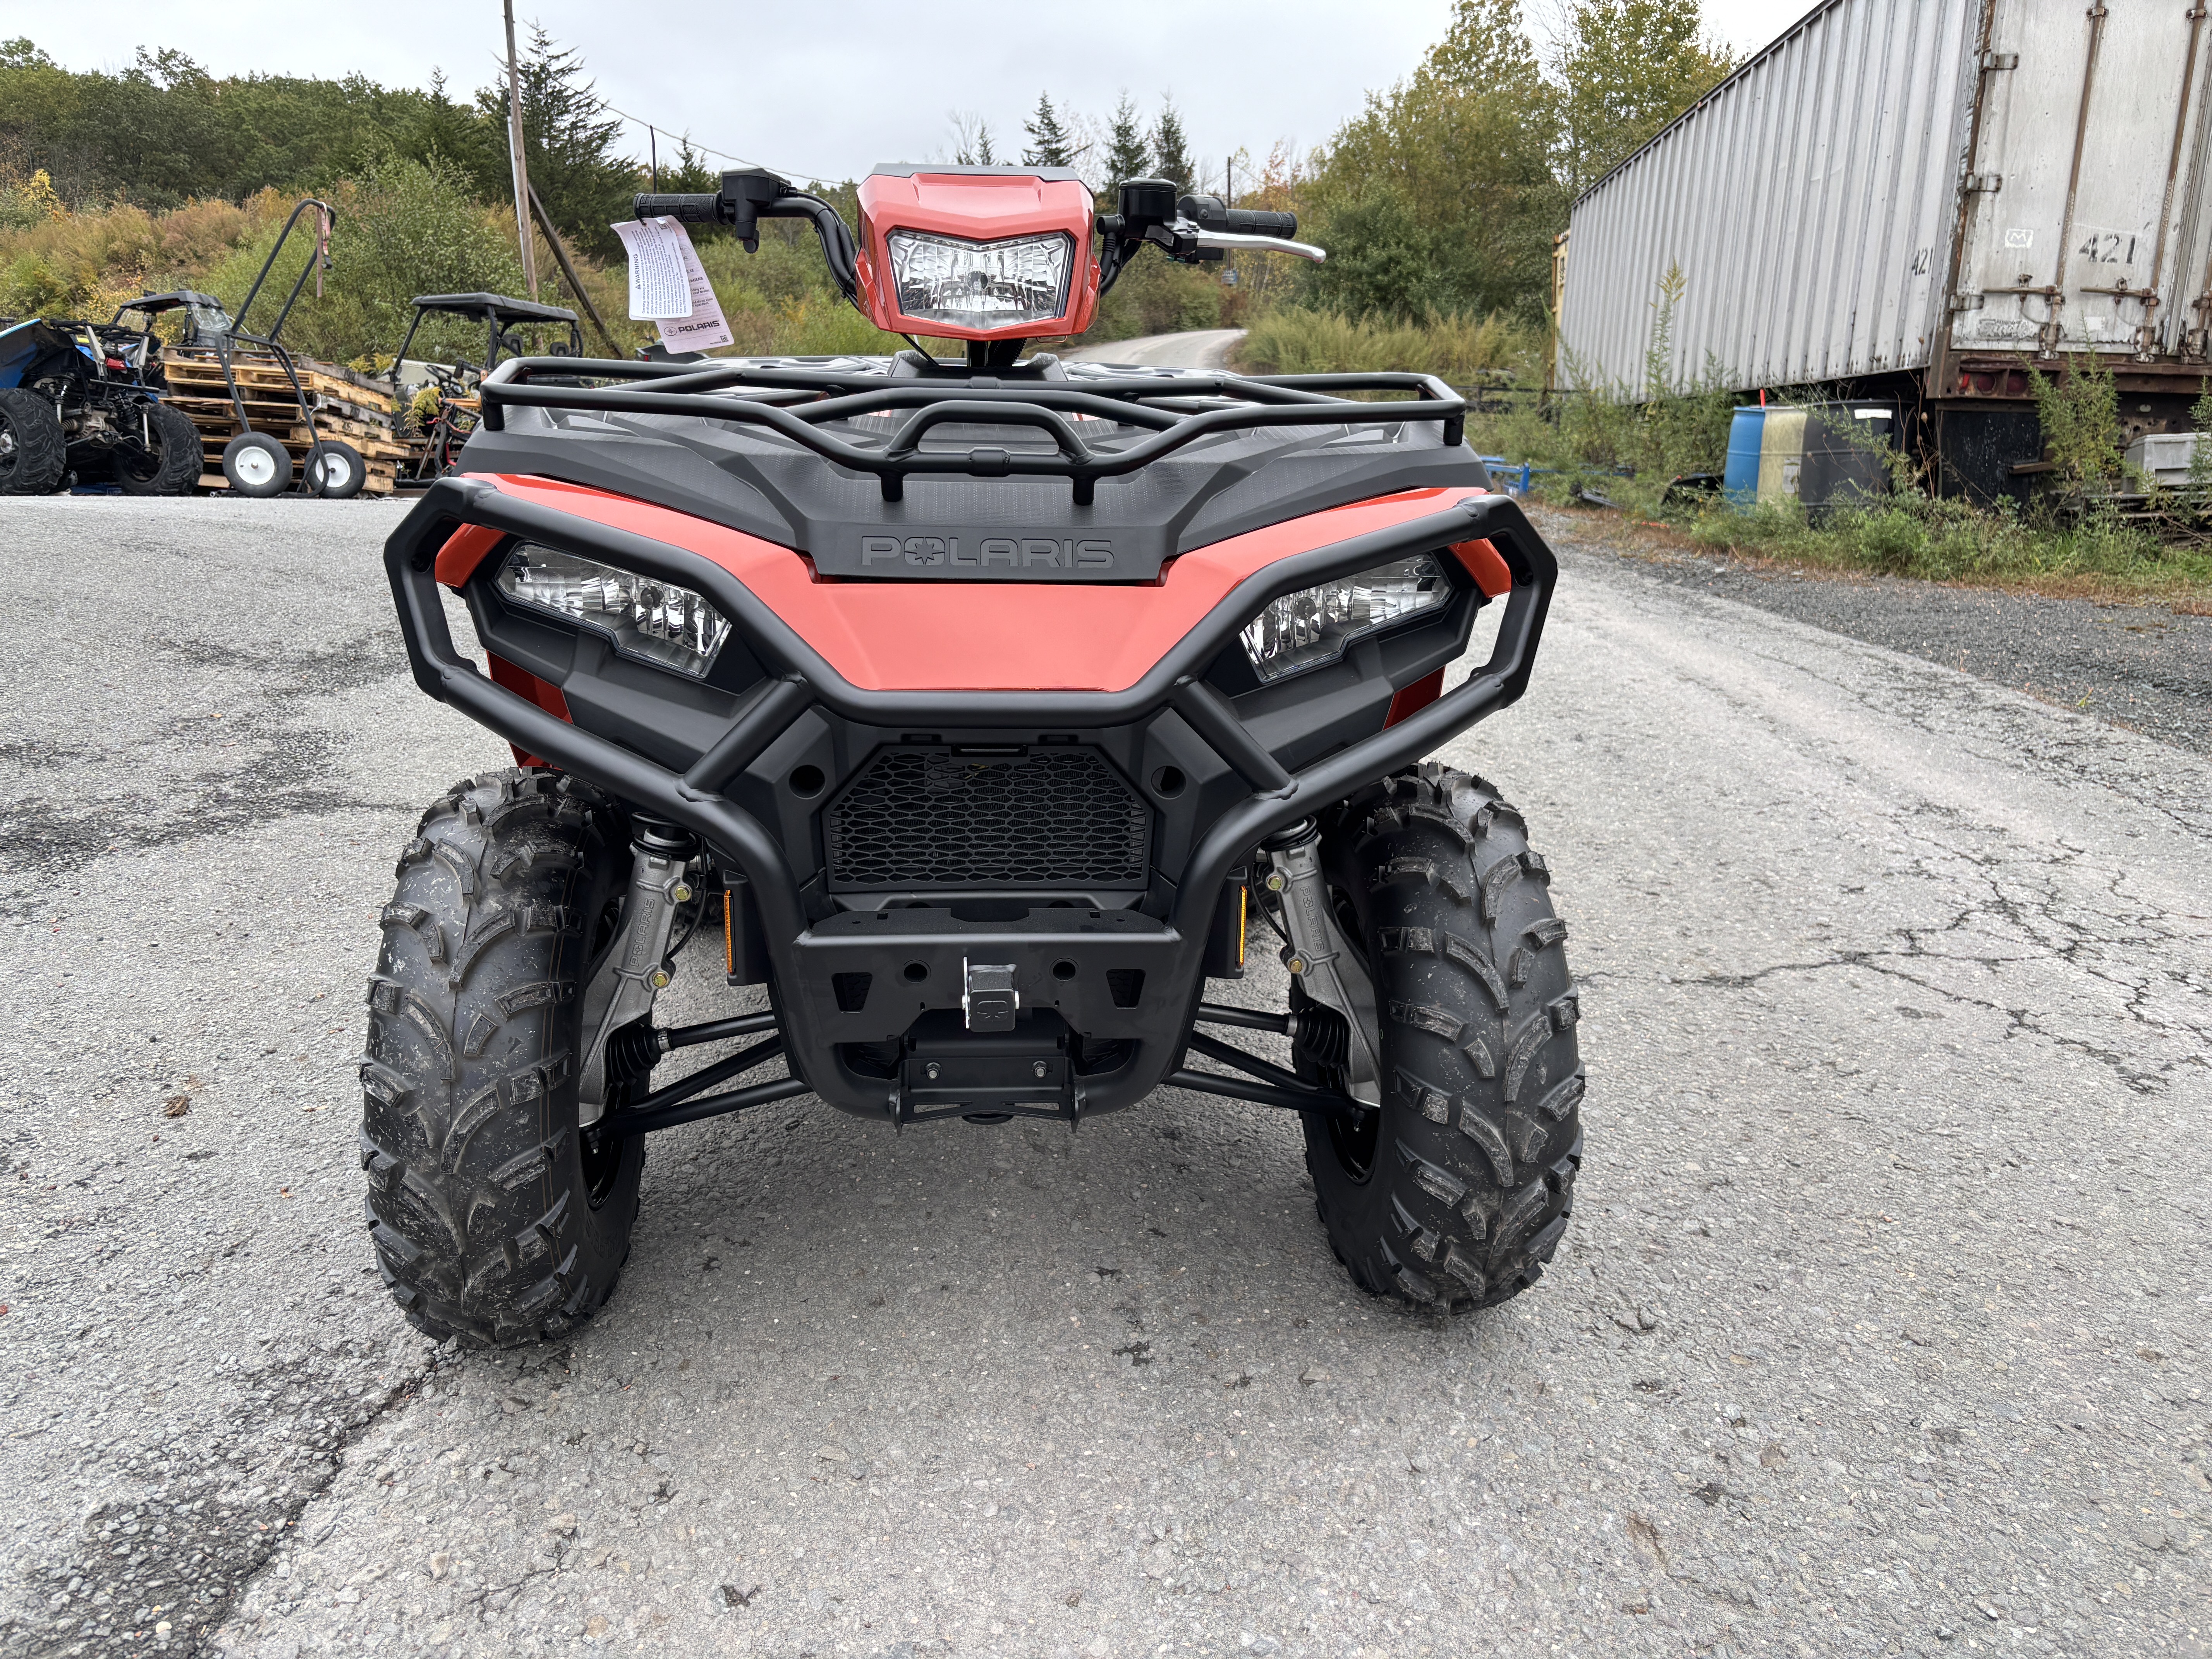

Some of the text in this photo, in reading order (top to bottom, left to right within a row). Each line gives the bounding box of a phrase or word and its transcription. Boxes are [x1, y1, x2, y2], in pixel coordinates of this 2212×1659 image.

[2079, 233, 2136, 264] 421
[678, 320, 720, 333] POLARIS
[861, 536, 1115, 568] POLARIS
[630, 898, 655, 967] POLARIS
[1300, 886, 1324, 952] POLARIS
